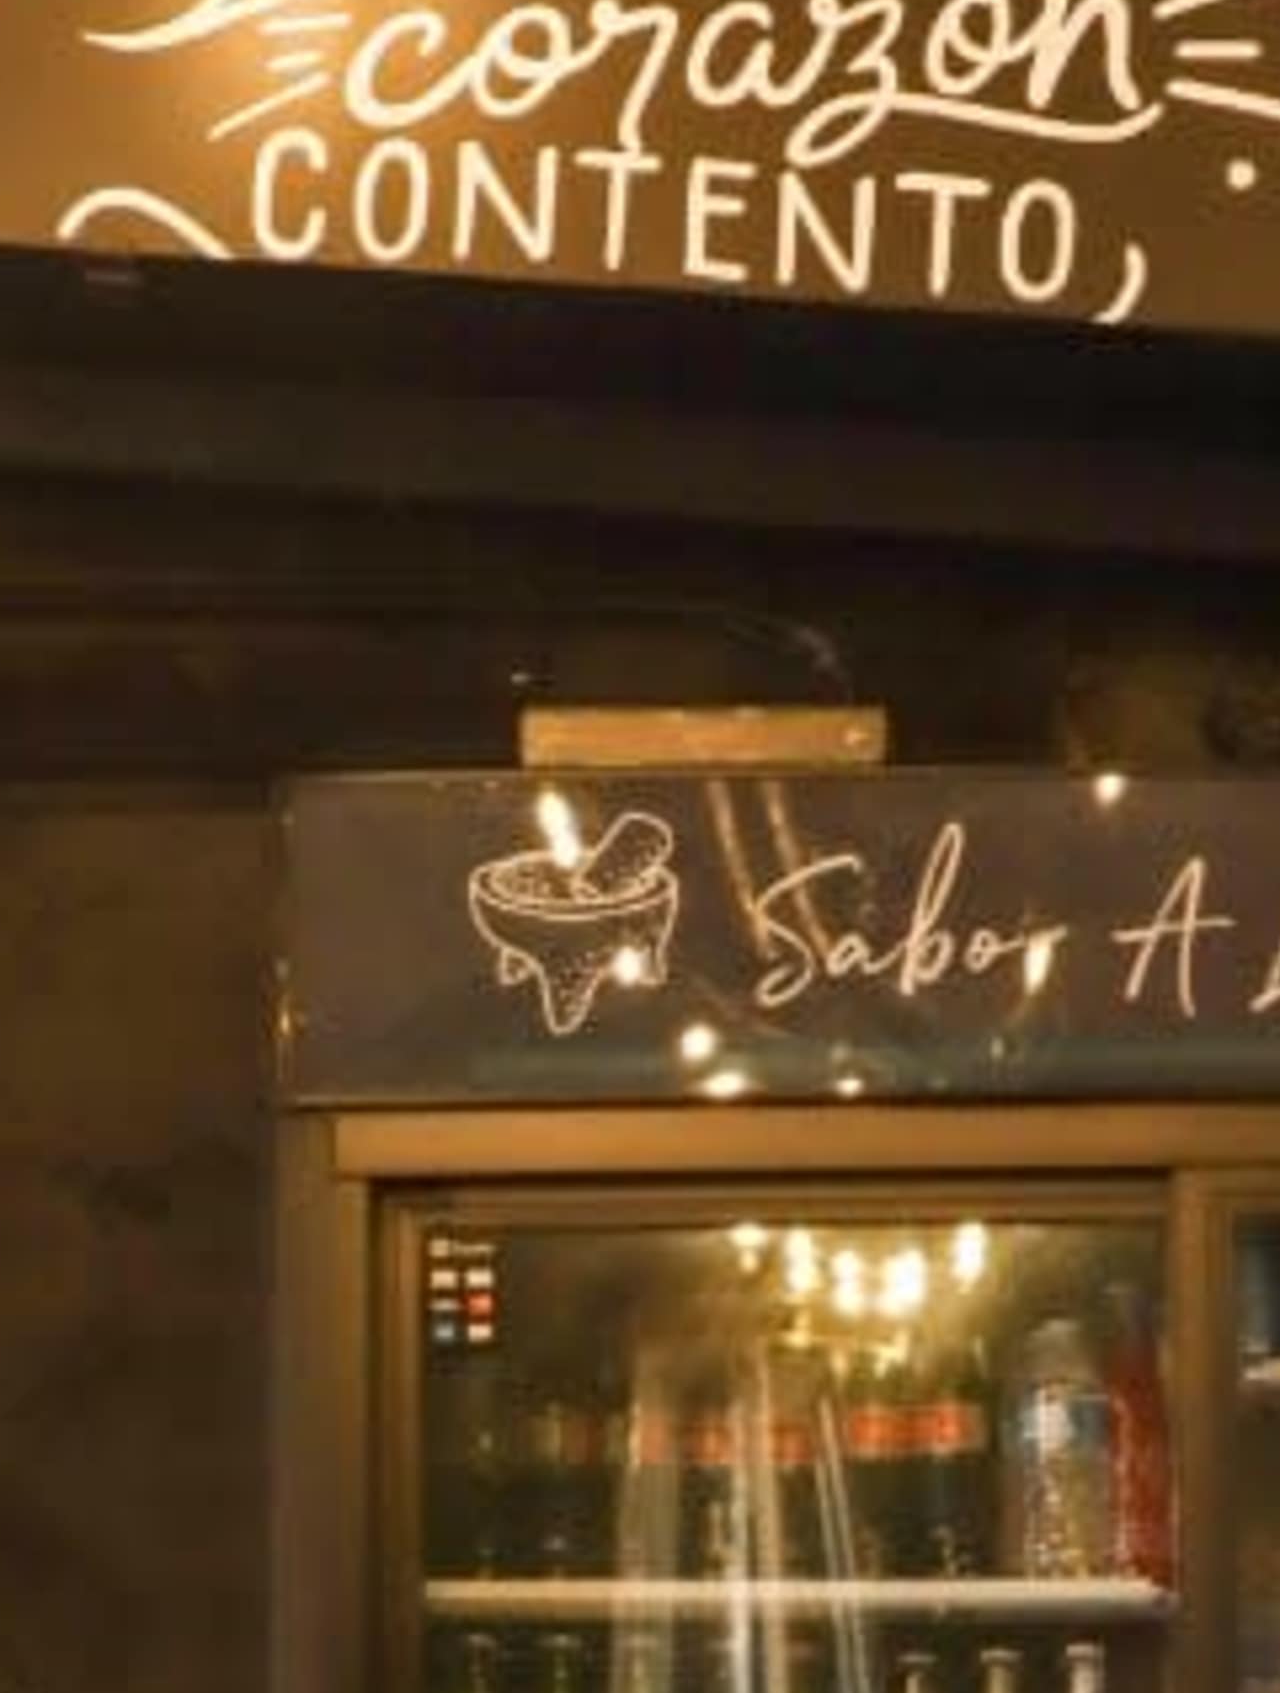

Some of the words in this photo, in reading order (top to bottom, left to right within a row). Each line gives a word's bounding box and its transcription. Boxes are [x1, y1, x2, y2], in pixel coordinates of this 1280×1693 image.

[250, 127, 1078, 302] CONTENTO
[748, 821, 1068, 1009] Sabor
[1110, 855, 1236, 1019] A
